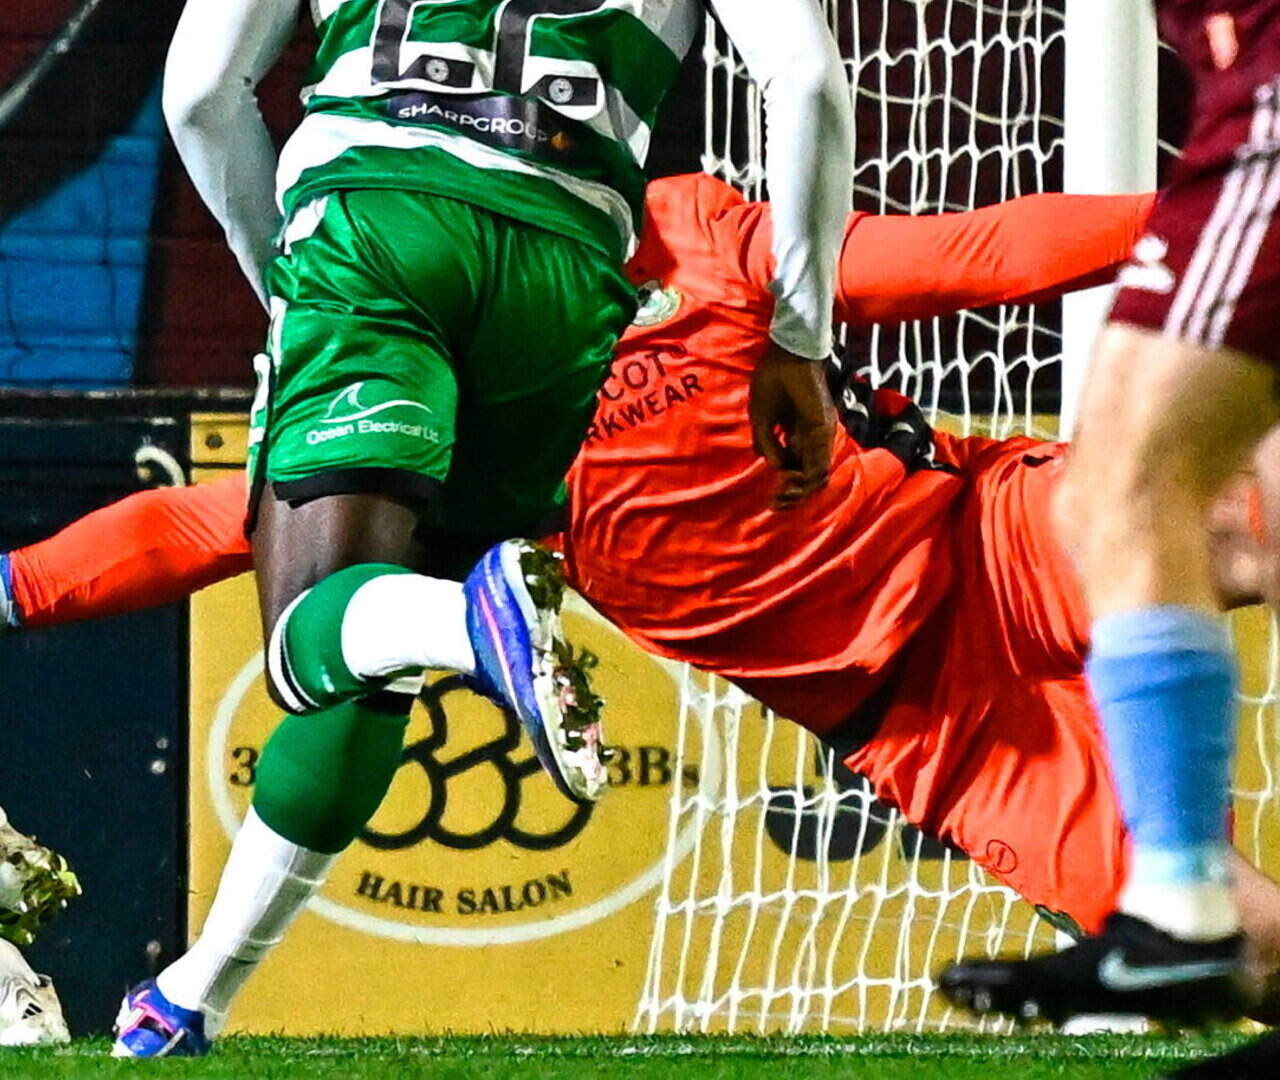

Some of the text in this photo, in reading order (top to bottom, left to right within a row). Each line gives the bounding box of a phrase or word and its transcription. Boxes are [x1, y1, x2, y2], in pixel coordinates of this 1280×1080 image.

[305, 423, 355, 445] Ocean
[357, 419, 421, 438] Electrical
[354, 867, 575, 916] HAIR SALON
